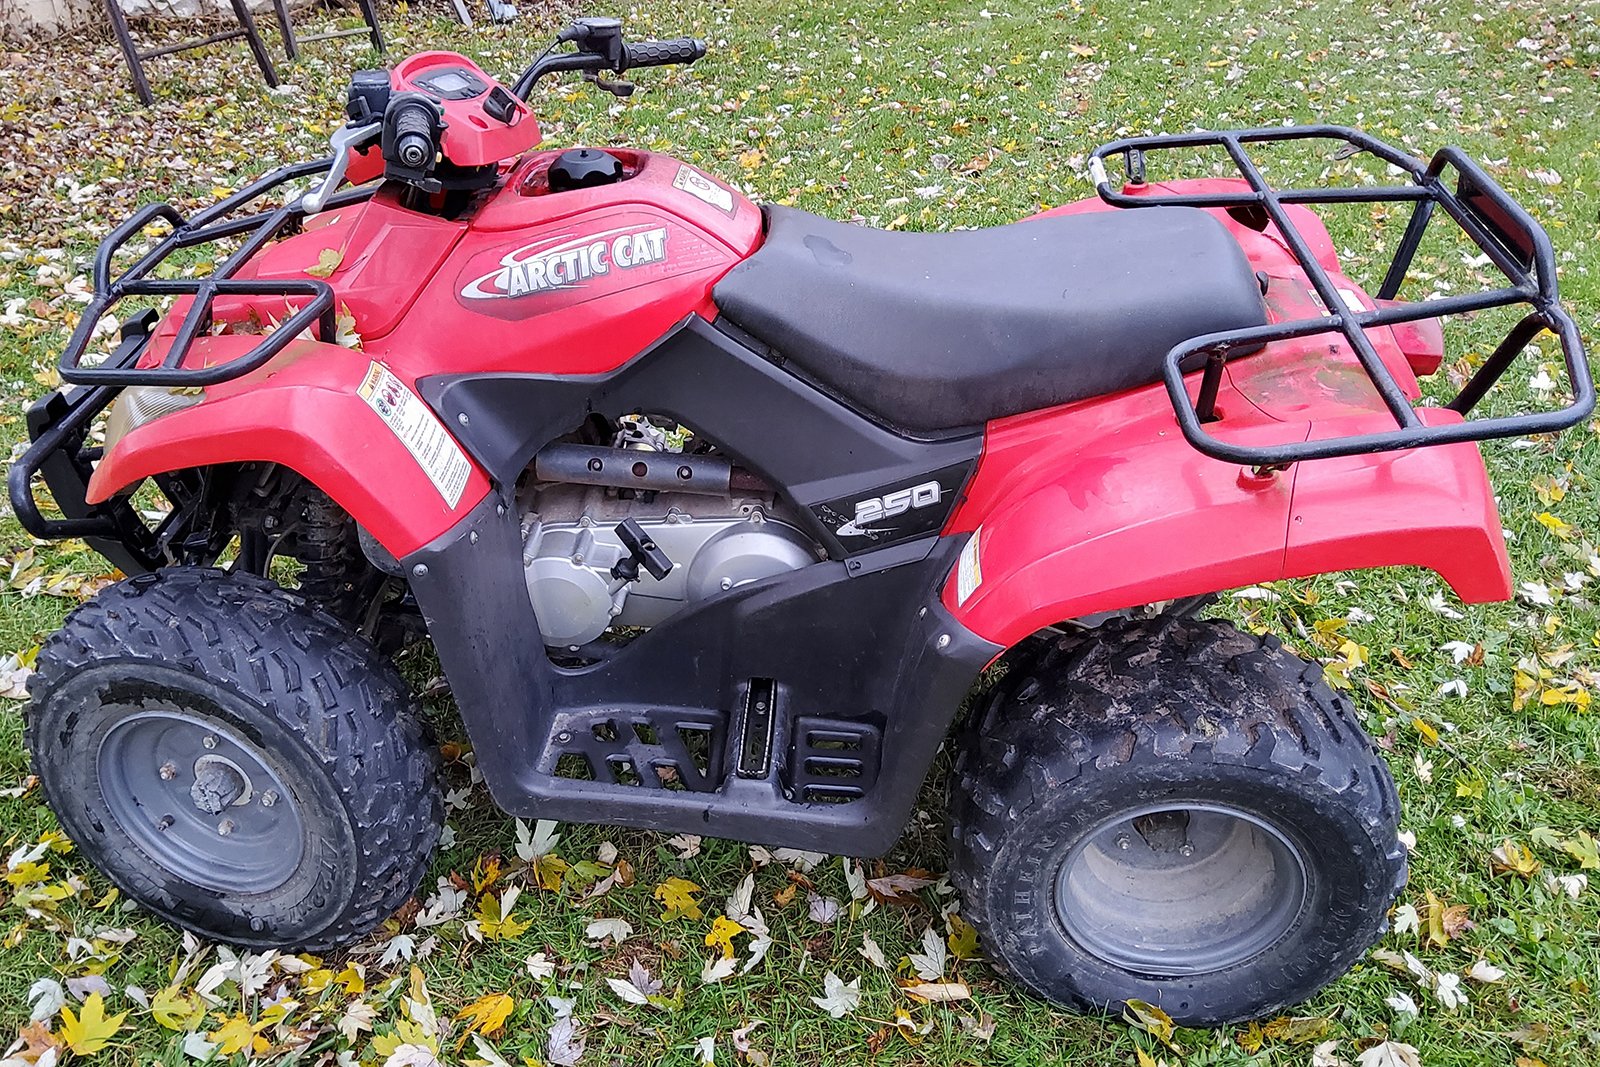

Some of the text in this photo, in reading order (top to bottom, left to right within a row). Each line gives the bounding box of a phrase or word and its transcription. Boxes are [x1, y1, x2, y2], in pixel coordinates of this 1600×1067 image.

[508, 241, 610, 298] ARCTIC
[611, 227, 668, 269] CAT
[854, 480, 942, 526] 250
